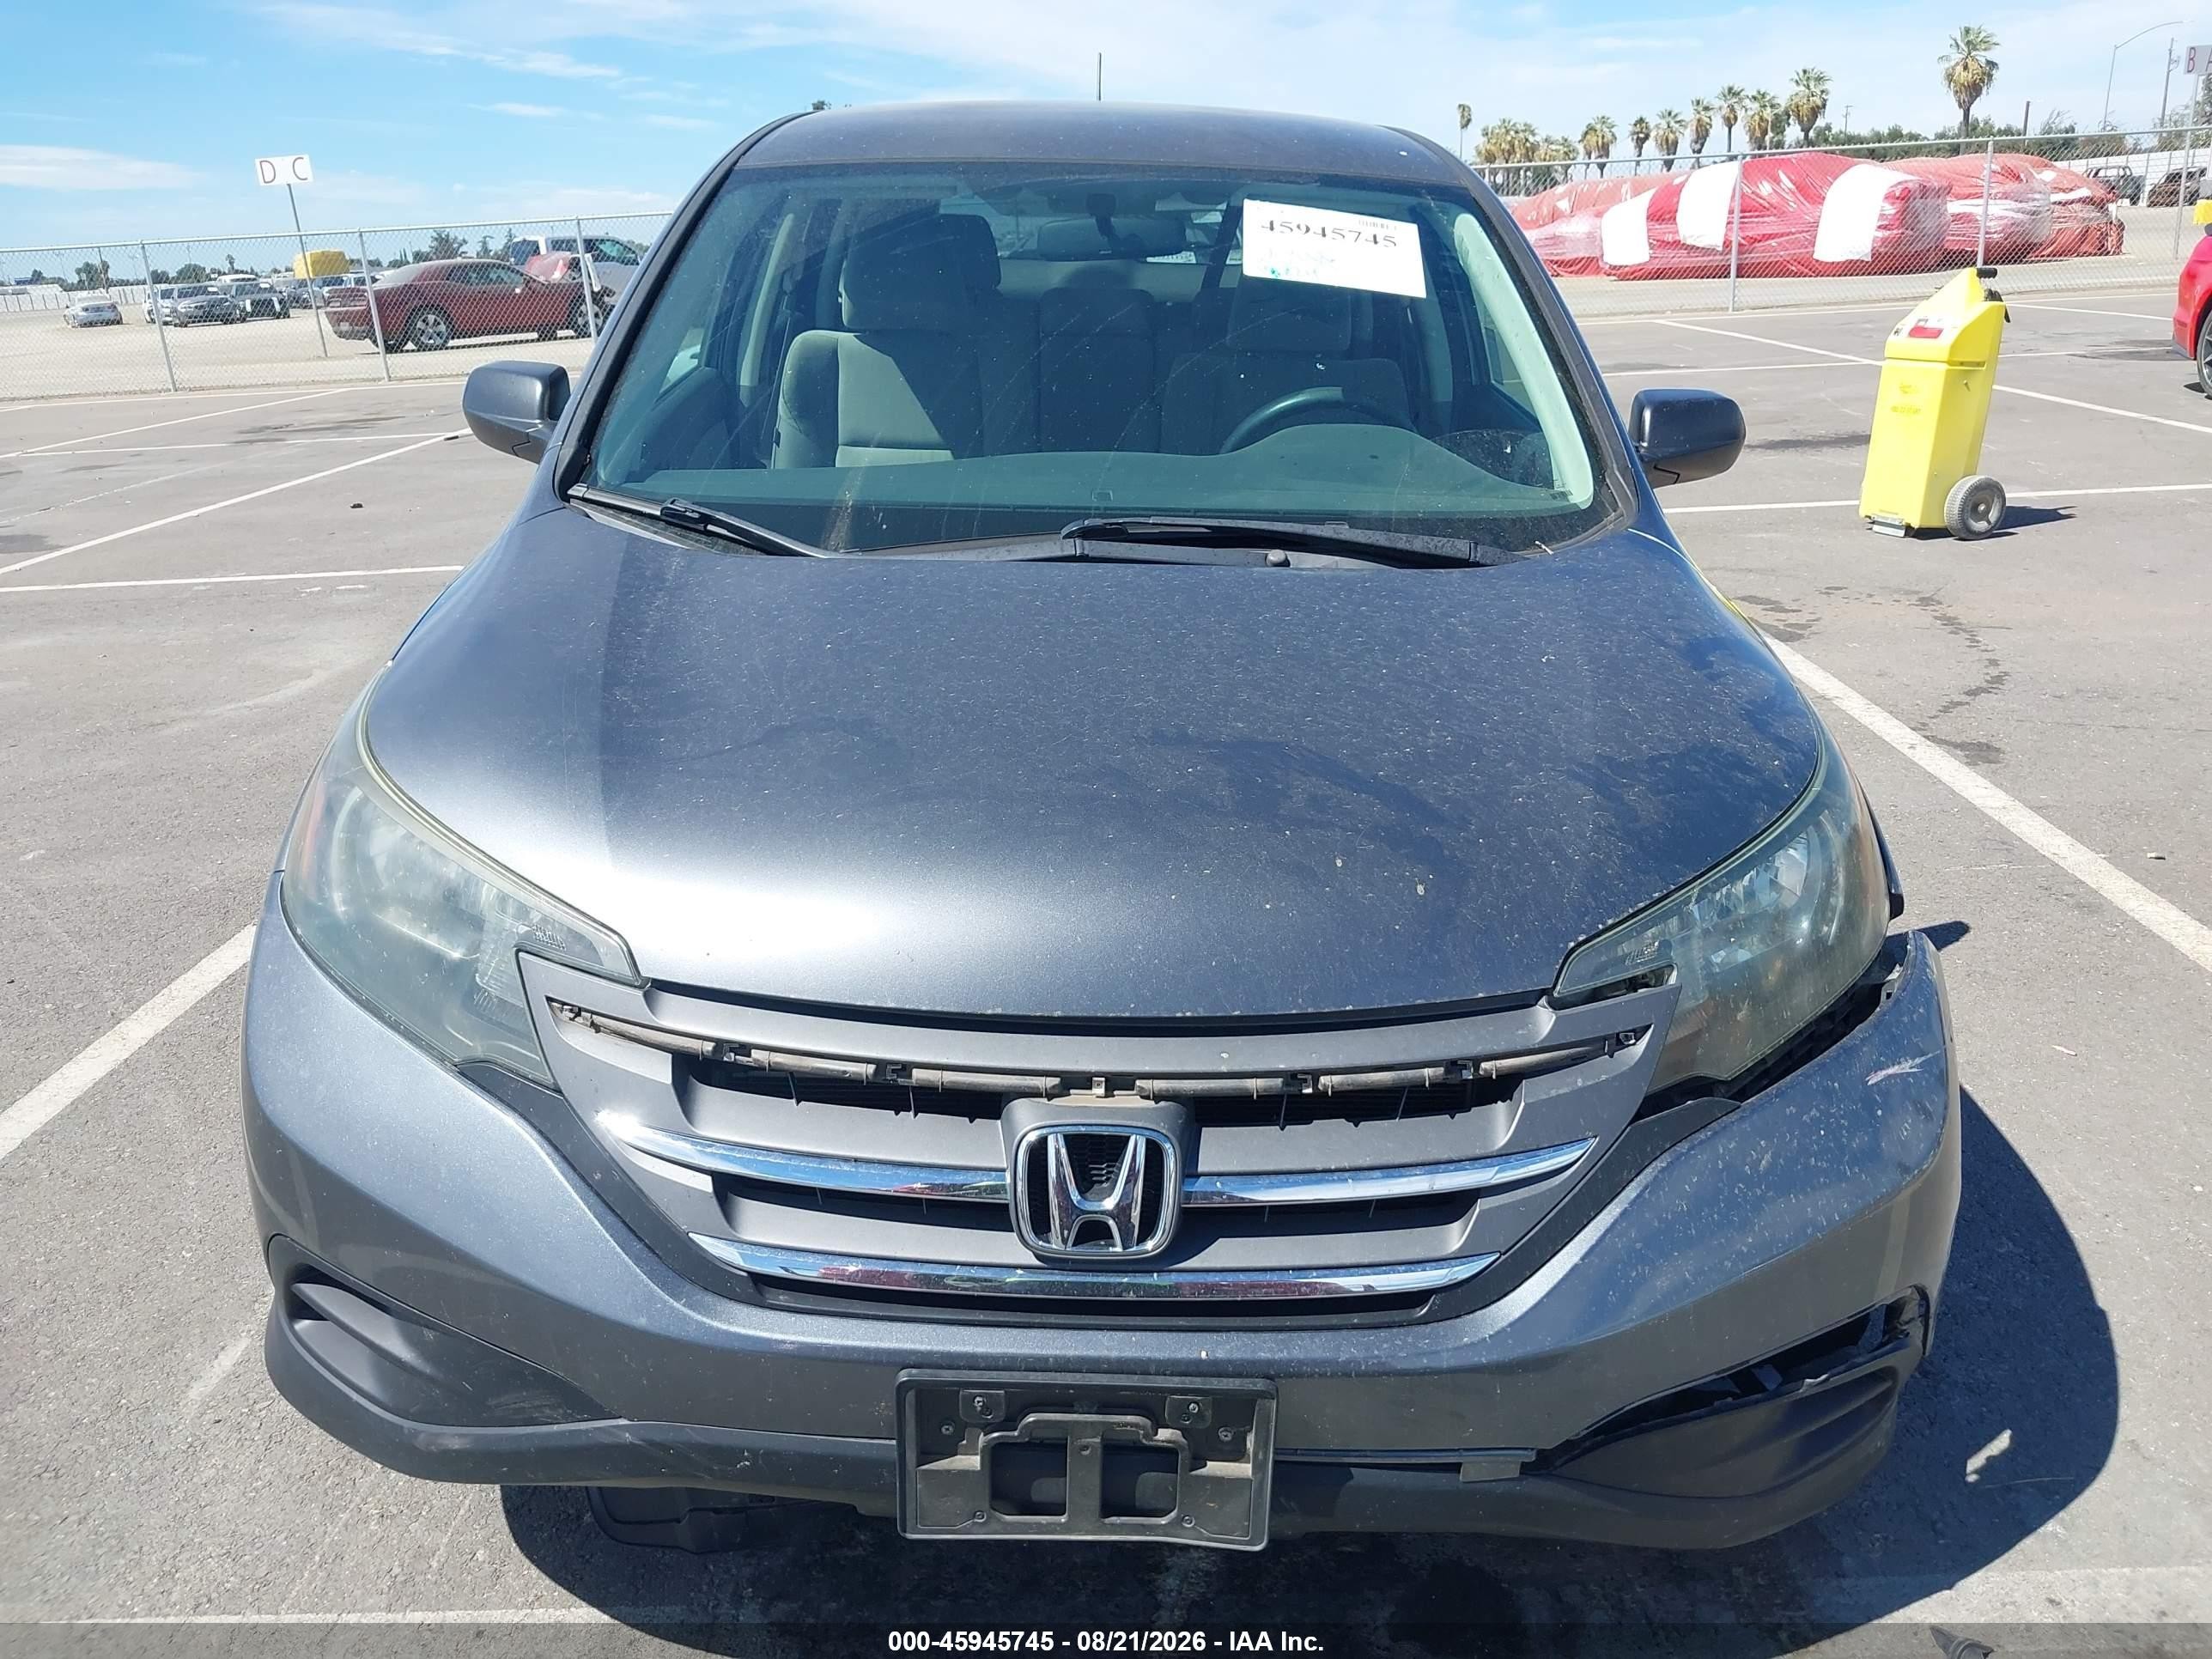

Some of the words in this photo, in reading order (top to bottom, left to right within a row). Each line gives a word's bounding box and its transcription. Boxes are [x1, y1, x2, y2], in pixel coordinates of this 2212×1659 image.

[2187, 46, 2196, 73] B
[259, 160, 276, 184] D
[293, 156, 307, 180] C
[1261, 220, 1396, 247] 45945745
